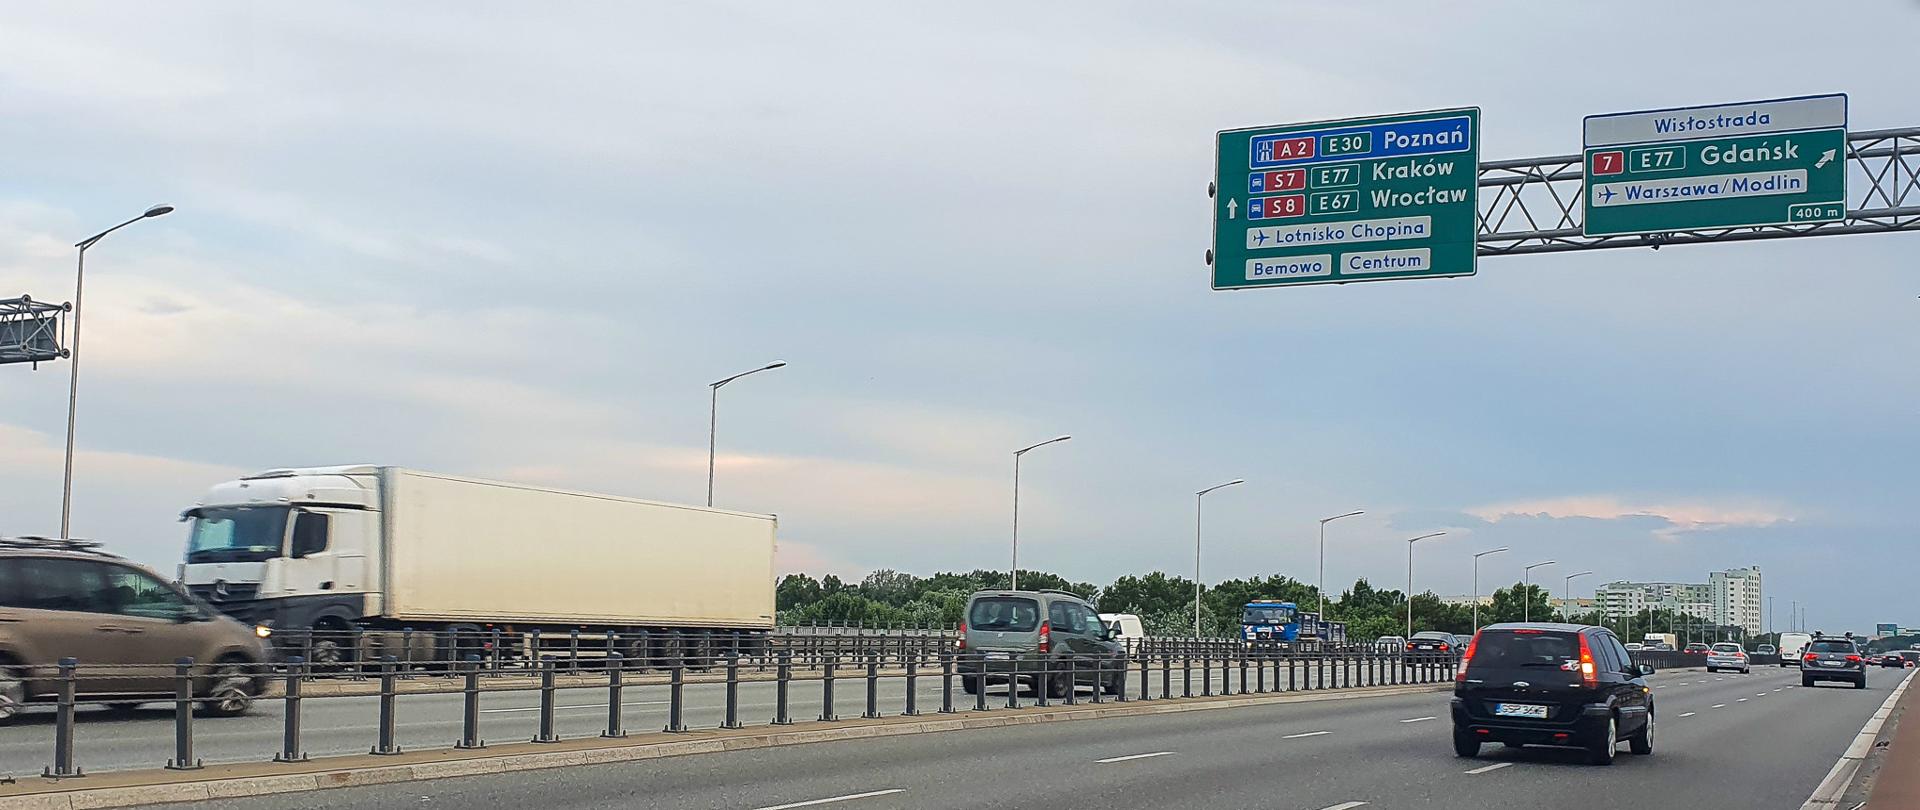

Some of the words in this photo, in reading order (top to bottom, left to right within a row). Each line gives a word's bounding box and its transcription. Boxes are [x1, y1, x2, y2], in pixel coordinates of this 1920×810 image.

[1655, 110, 1770, 133] Wisłostrada
[1384, 125, 1463, 149] Poznań
[1602, 156, 1612, 171] 7
[1700, 140, 1799, 165] Gdańsk
[1372, 158, 1454, 181] Kraków
[1370, 186, 1467, 208] Wrocław
[1625, 175, 1800, 201] Warszawa/Modlin
[1796, 207, 1821, 218] 400
[1827, 208, 1838, 217] m
[1276, 225, 1345, 244] Lotnisko
[1351, 221, 1424, 241] Chopina
[1254, 261, 1322, 276] Bemowo
[1349, 255, 1421, 270] Centrum
